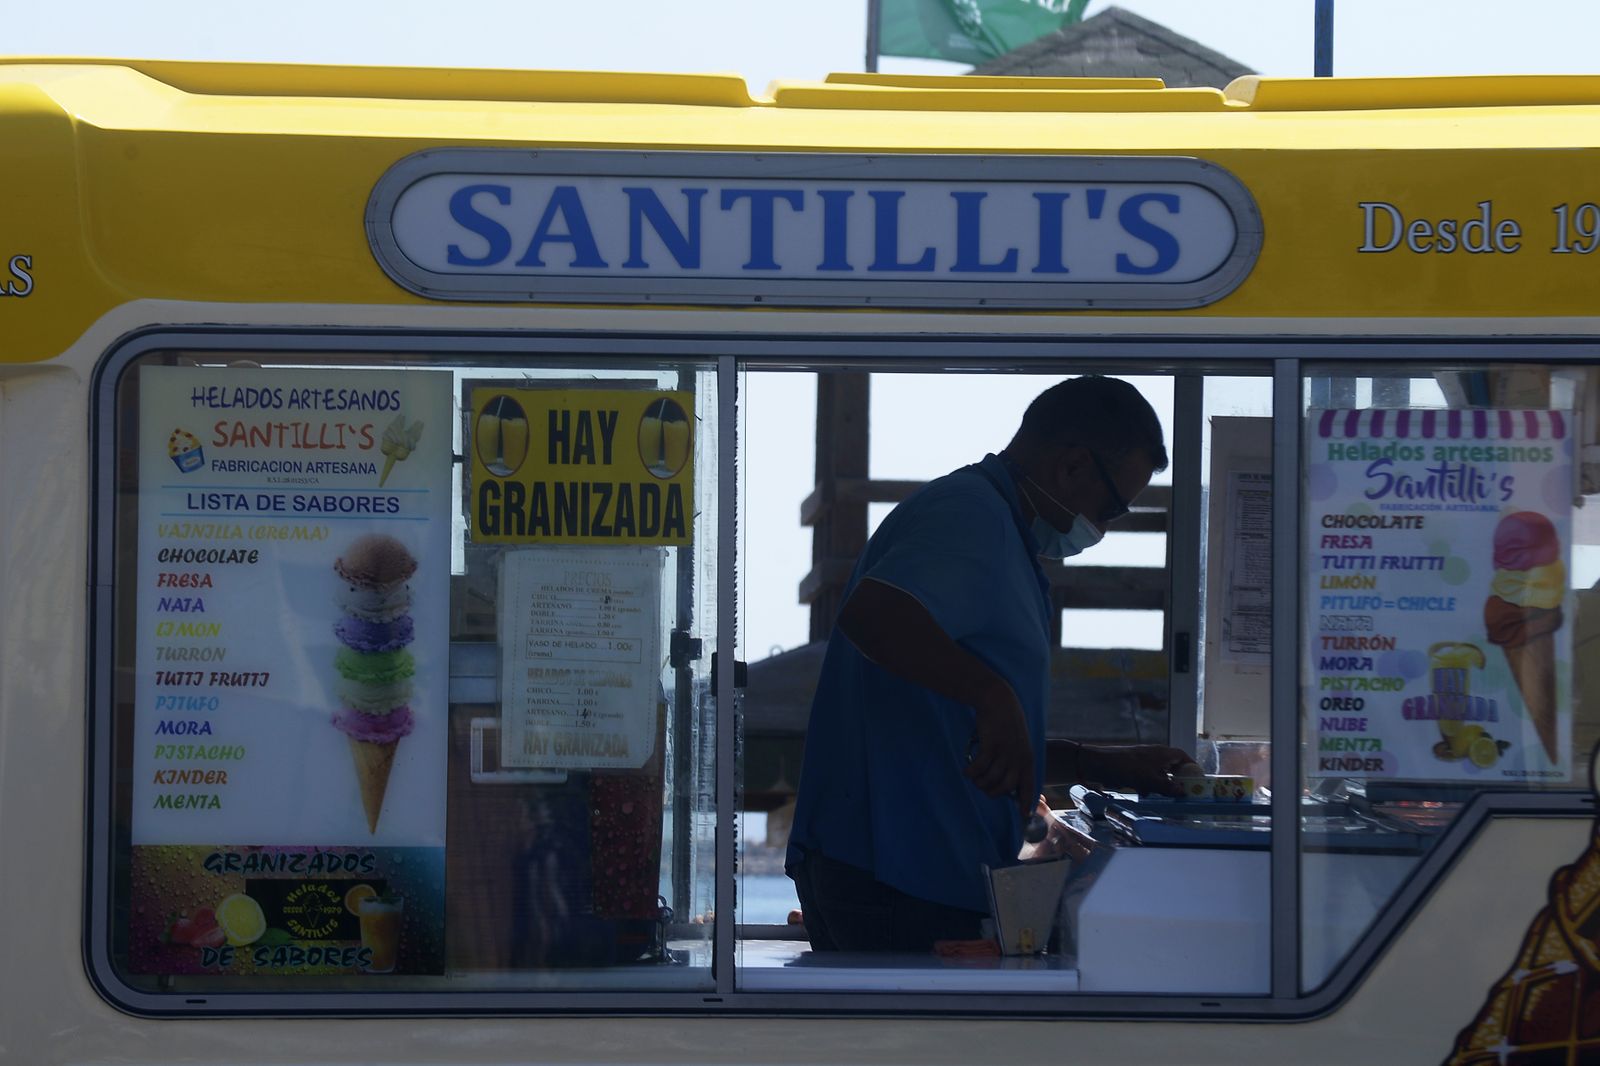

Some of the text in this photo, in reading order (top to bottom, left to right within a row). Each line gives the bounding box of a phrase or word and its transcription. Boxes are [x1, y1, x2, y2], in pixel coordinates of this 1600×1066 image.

[446, 183, 1181, 276] SANTILLI'S
[1357, 200, 1600, 254] Desde 19
[191, 387, 400, 411] HELADOS ARTESANOS
[548, 410, 619, 465] HAY
[1327, 441, 1553, 463] Helados artesanos
[212, 460, 302, 474] FABRICACION
[306, 461, 376, 475] ARTESANA
[1364, 457, 1515, 504] Santilli's
[188, 493, 400, 513] LISTA DE SABORES
[479, 479, 686, 538] GRANIZADA
[1321, 514, 1425, 530] CHOCOLATE
[158, 524, 330, 541] VAINILLA (CREMA)
[1320, 535, 1373, 550] FRESA
[158, 548, 259, 564] CHOCOLATE
[1321, 555, 1445, 571] TUTTI FRUTTI
[157, 573, 213, 588] FRESA
[1320, 572, 1376, 590] LIMÓN
[157, 596, 205, 612] NATA
[552, 640, 561, 649] DE
[1320, 635, 1397, 651] TURRÓN
[1320, 656, 1373, 671] MORA
[155, 670, 269, 688] TUTTI FRUTTI
[1319, 677, 1405, 692] PISTACHO
[526, 686, 552, 694] CHICO
[154, 695, 219, 711] PITUFO
[1319, 697, 1364, 712] OREO
[154, 720, 212, 736] MORA
[1319, 717, 1368, 732] NUBE
[153, 744, 245, 760] PISTACHO
[1319, 737, 1383, 752] MENTA
[1319, 757, 1384, 772] KINDER
[153, 770, 227, 786] KINDER
[153, 795, 221, 810] MENTA
[203, 852, 376, 875] GRANIZADOS
[201, 946, 373, 968] DE SABORES
